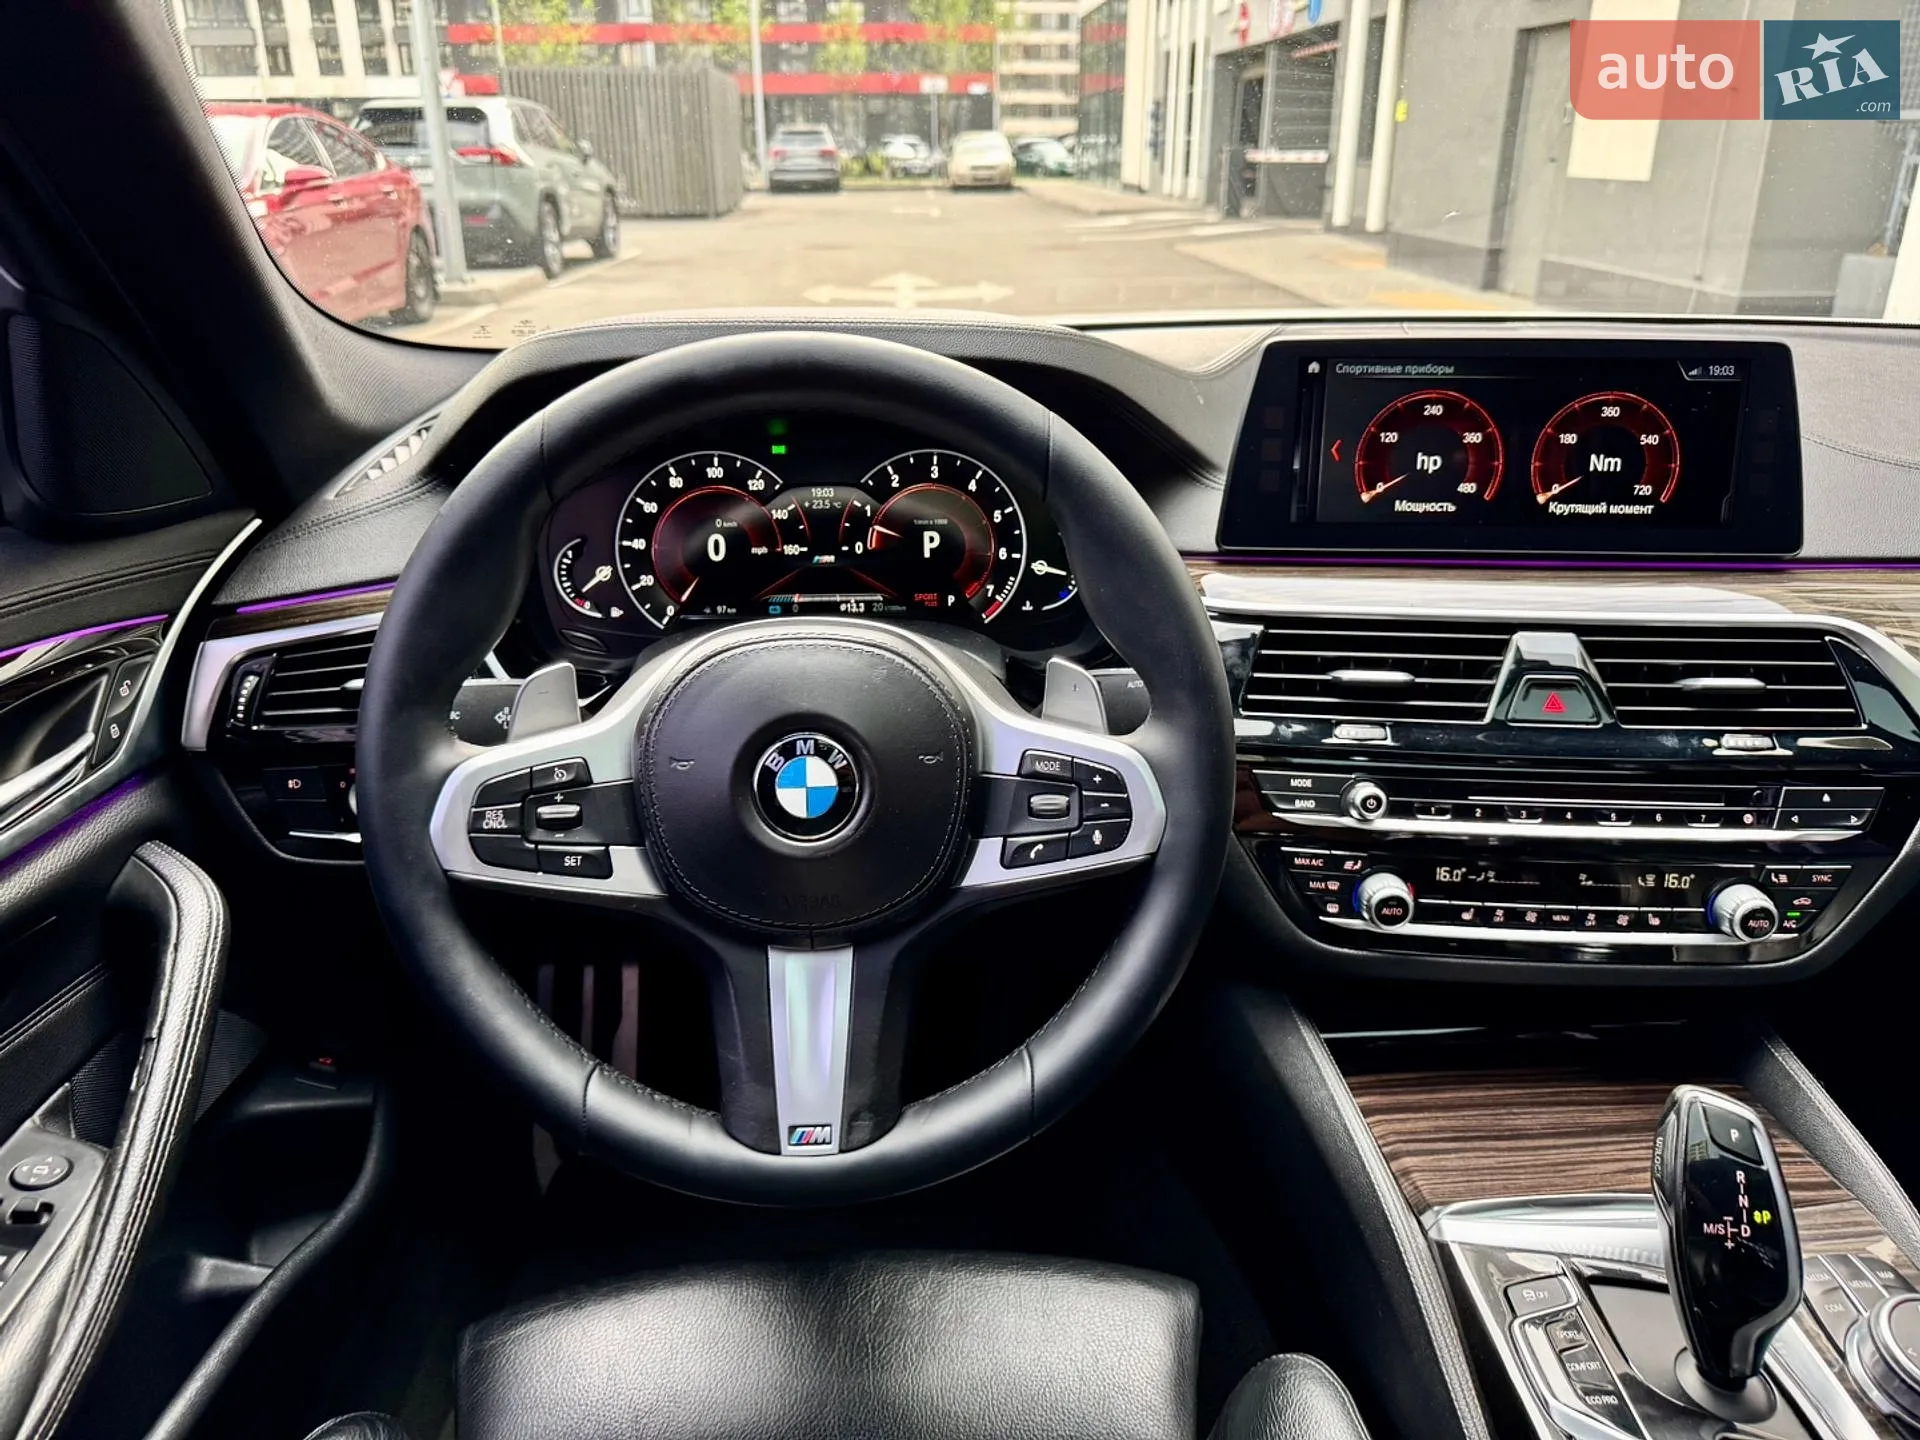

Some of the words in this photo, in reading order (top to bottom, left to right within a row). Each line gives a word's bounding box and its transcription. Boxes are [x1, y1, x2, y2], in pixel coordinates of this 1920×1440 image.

[1335, 363, 1402, 377] Спортивные
[1404, 364, 1455, 377] приборы
[1708, 365, 1735, 377] 19:03
[1423, 404, 1443, 417] 240
[1600, 406, 1620, 418] 360
[1379, 432, 1398, 444] 120
[1462, 432, 1483, 444] 360
[1558, 433, 1577, 445] 180
[1639, 434, 1659, 446] 540
[1415, 451, 1442, 473] hp
[1589, 453, 1622, 472] Nm
[706, 466, 723, 479] 100
[930, 466, 939, 479] 3
[669, 476, 683, 489] 80
[747, 479, 765, 491] 120
[890, 475, 900, 487] 2
[968, 480, 977, 492] 4
[811, 488, 834, 498] 19:03
[1457, 482, 1477, 494] 480
[1633, 484, 1652, 496] 720
[643, 502, 658, 514] 60
[812, 500, 831, 509] 23.5
[1394, 500, 1456, 514] Мощность
[1548, 501, 1607, 516] Крутящий
[1609, 503, 1654, 515] момент
[772, 509, 788, 520] 140
[864, 505, 871, 517] 1
[993, 510, 1002, 522] 5
[631, 538, 646, 550] 40
[707, 533, 726, 562] 0
[751, 545, 768, 555] mph
[783, 544, 800, 555] 160
[854, 542, 864, 554] 0
[923, 531, 941, 558] P
[999, 548, 1008, 560] 6
[639, 574, 654, 586] 20
[985, 585, 995, 597] 7
[947, 595, 956, 606] P
[666, 605, 675, 617] 0
[716, 605, 726, 614] 97
[764, 739, 849, 773] BMW
[1034, 760, 1061, 772] MODE
[1290, 777, 1312, 788] MODE
[1294, 799, 1316, 809] BAND
[485, 810, 504, 820] RES
[1430, 807, 1436, 815] 1
[1475, 808, 1482, 817] 2
[1520, 810, 1527, 818] 3
[1565, 811, 1572, 819] 4
[1610, 813, 1617, 821] 5
[1656, 813, 1662, 822] 6
[1700, 814, 1706, 823] 7
[563, 856, 582, 867] SET
[1294, 856, 1310, 866] MAX
[1310, 857, 1324, 867] A/C
[1811, 874, 1832, 883] SYNC
[1309, 880, 1326, 890] MAX
[1381, 907, 1403, 916] AUTO
[1747, 919, 1769, 928] AUTO
[1783, 920, 1797, 928] A/C
[1730, 1129, 1740, 1142] P
[1736, 1171, 1745, 1183] R
[1739, 1194, 1749, 1207] N
[1703, 1223, 1725, 1234] M/S
[1741, 1225, 1751, 1237] D
[1566, 1361, 1602, 1371] COMFORT
[1585, 1396, 1601, 1405] ECO
[1601, 1395, 1619, 1405] PRO
